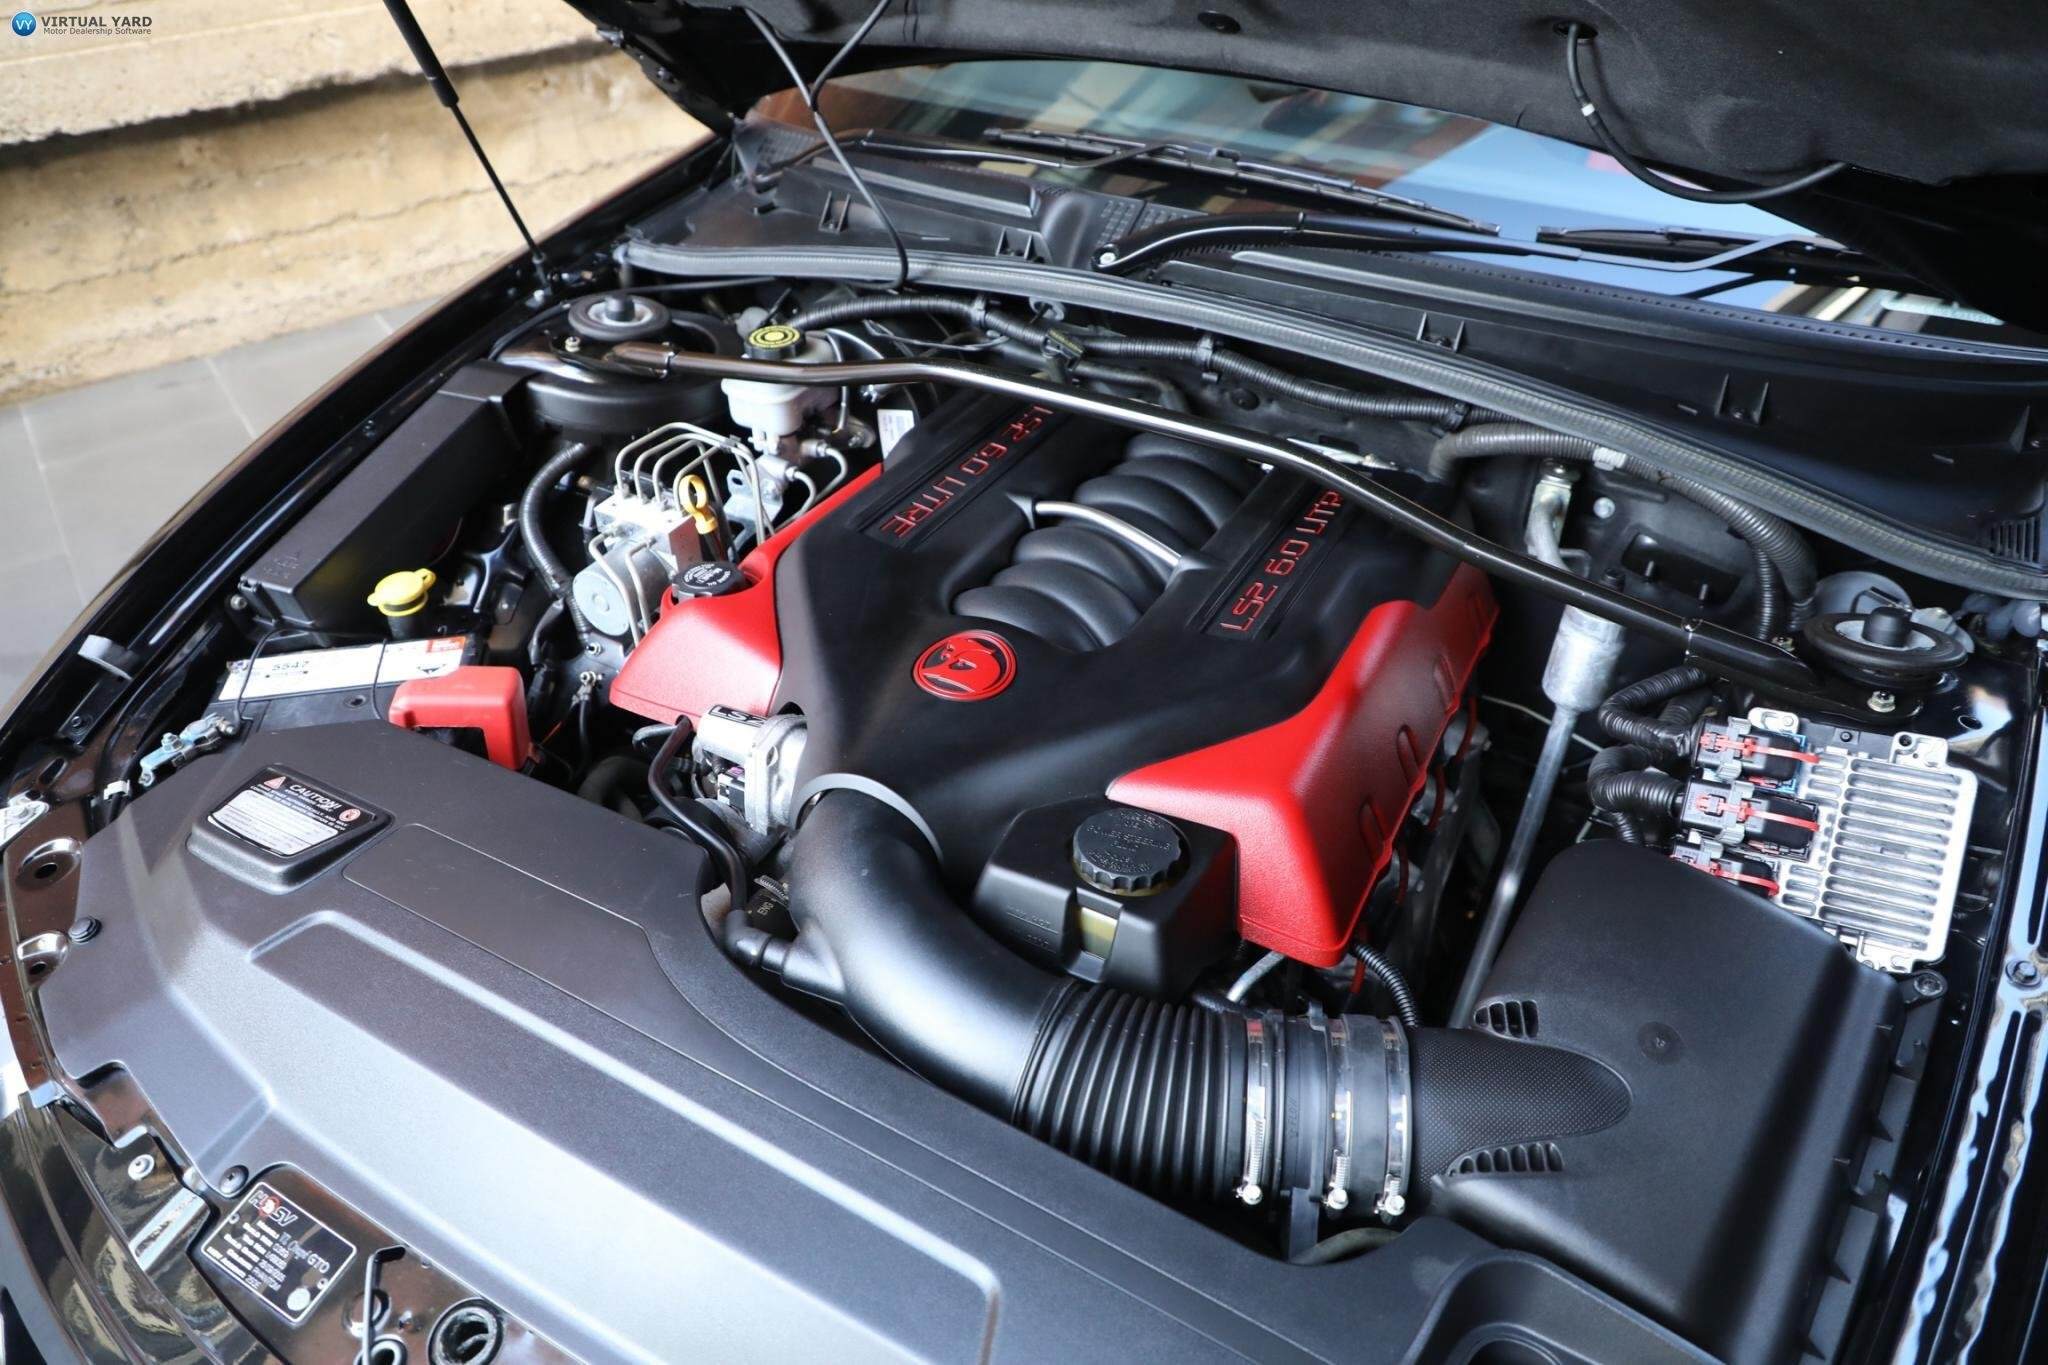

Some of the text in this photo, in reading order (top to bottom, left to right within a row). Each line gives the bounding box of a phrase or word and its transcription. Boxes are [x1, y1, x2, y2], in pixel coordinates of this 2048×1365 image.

[878, 475, 967, 539] LITRE
[1220, 578, 1280, 633] LS2
[1264, 537, 1312, 577] 6.0
[710, 705, 767, 724] LS2
[289, 784, 343, 809] CAUTION!
[307, 1252, 331, 1274] GTO
